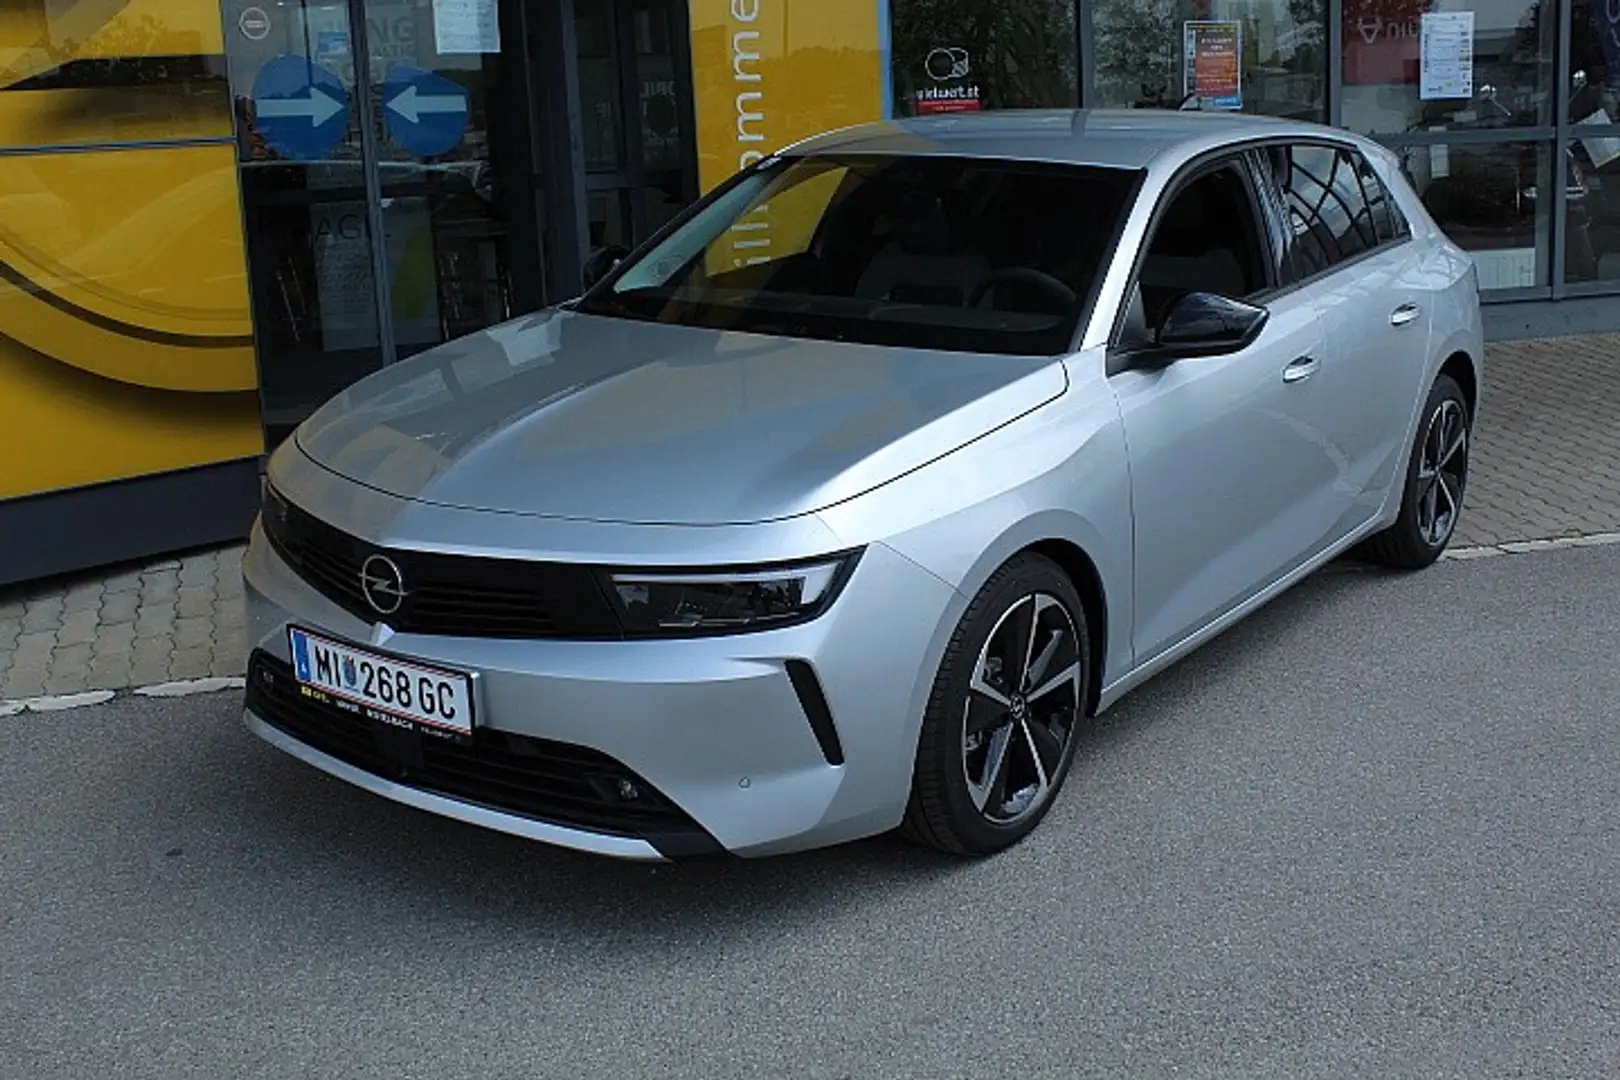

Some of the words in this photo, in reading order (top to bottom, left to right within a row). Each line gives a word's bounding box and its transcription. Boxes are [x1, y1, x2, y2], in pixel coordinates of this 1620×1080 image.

[315, 645, 341, 687] MI
[360, 662, 412, 708] 268
[418, 677, 456, 720] GC
